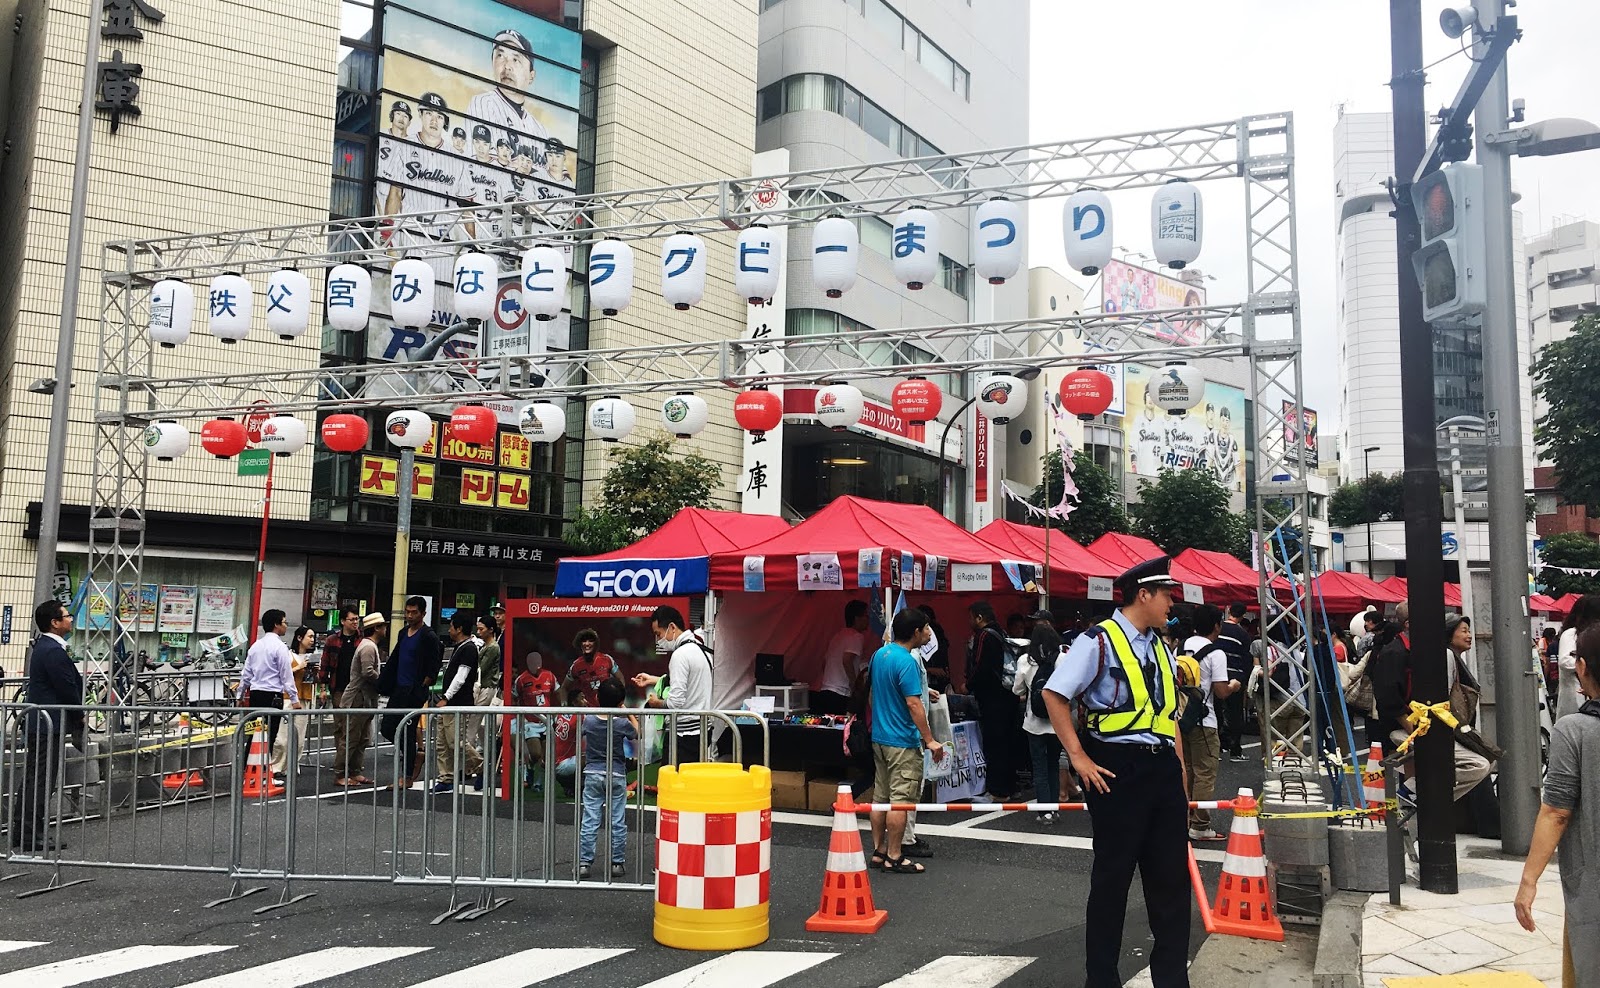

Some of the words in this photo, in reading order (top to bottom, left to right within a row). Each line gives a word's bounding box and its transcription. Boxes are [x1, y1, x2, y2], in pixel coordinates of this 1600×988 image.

[405, 161, 456, 186] Swallows
[485, 189, 498, 202] 29
[1162, 224, 1193, 233] ラグビー
[210, 289, 236, 318] 秩
[267, 284, 293, 314] 父
[329, 277, 357, 308] 宮
[392, 274, 422, 302] み
[455, 266, 485, 294] な
[525, 261, 554, 291] と
[590, 253, 616, 286] ラ
[665, 247, 697, 278] グ
[740, 242, 770, 273] ビ
[815, 244, 848, 254] ー
[895, 222, 926, 258] ま
[980, 217, 1016, 248] つ
[1072, 203, 1106, 241] り
[502, 434, 529, 452] 懸賞金
[1165, 453, 1208, 469] RISING
[394, 538, 543, 562] 南信用金庫青山支店
[582, 568, 676, 598] SECOM
[962, 573, 975, 582] Rugby
[975, 573, 988, 581] Online
[580, 604, 629, 613] #5beyond2019
[555, 717, 570, 740] 23
